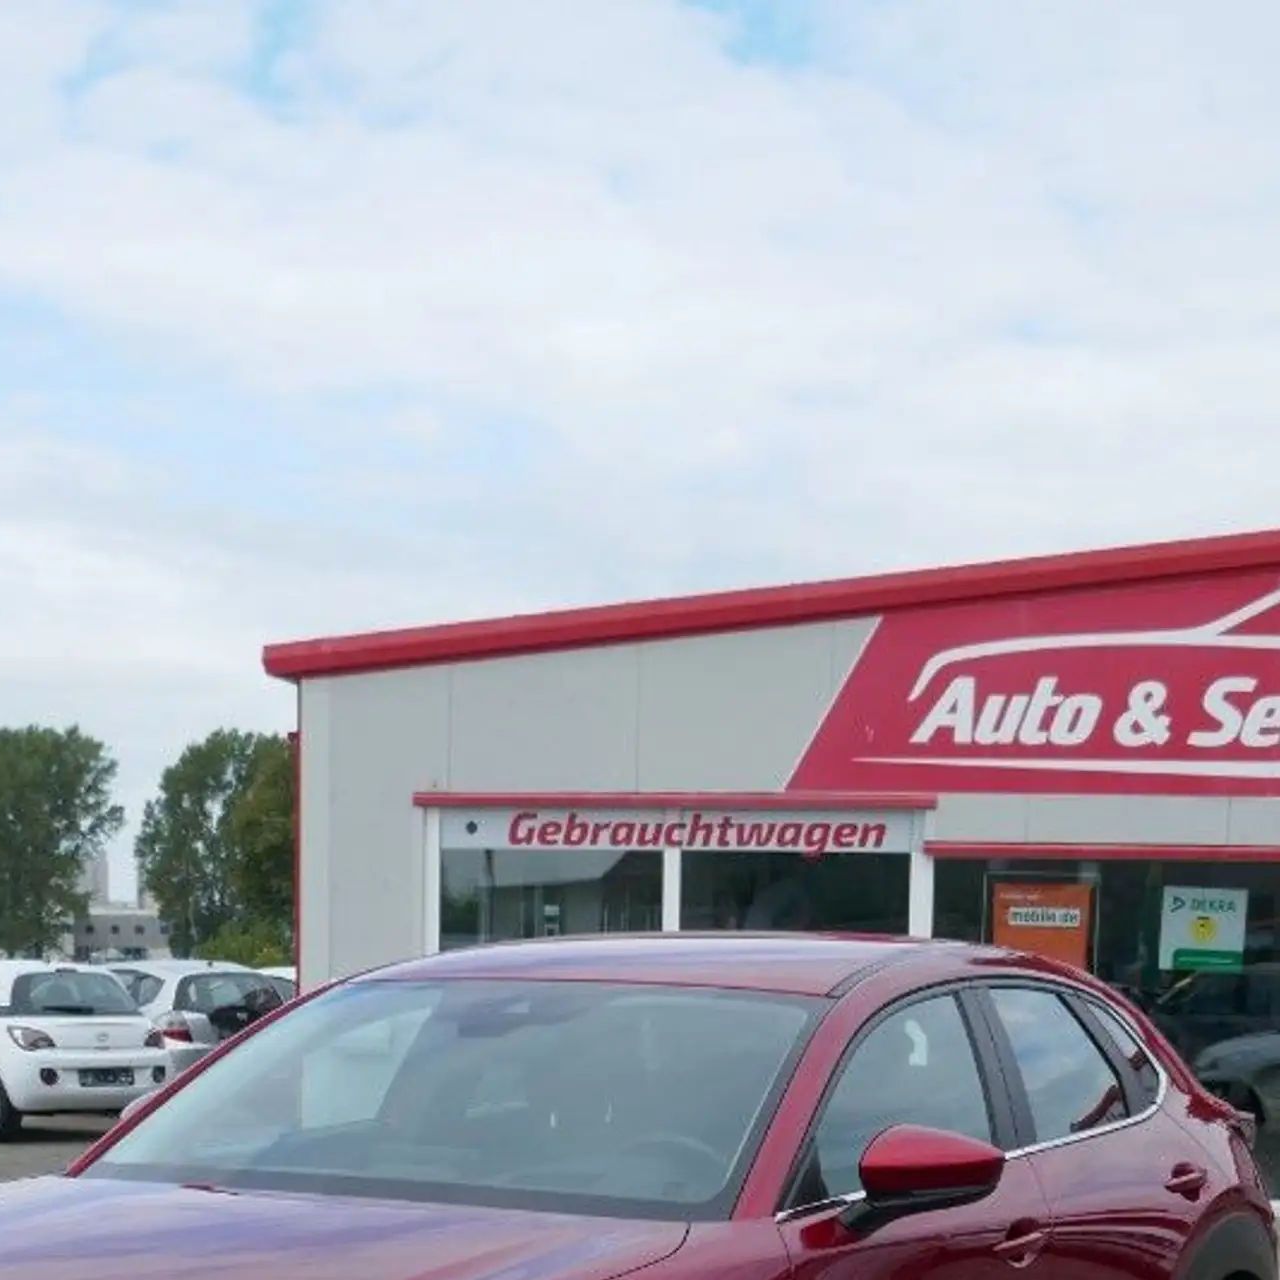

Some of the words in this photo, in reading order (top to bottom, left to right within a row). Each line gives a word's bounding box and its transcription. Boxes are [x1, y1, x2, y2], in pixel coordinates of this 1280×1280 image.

[908, 674, 1104, 746] Auto
[1113, 679, 1172, 748] &
[507, 810, 887, 858] Gebrauchtwagen
